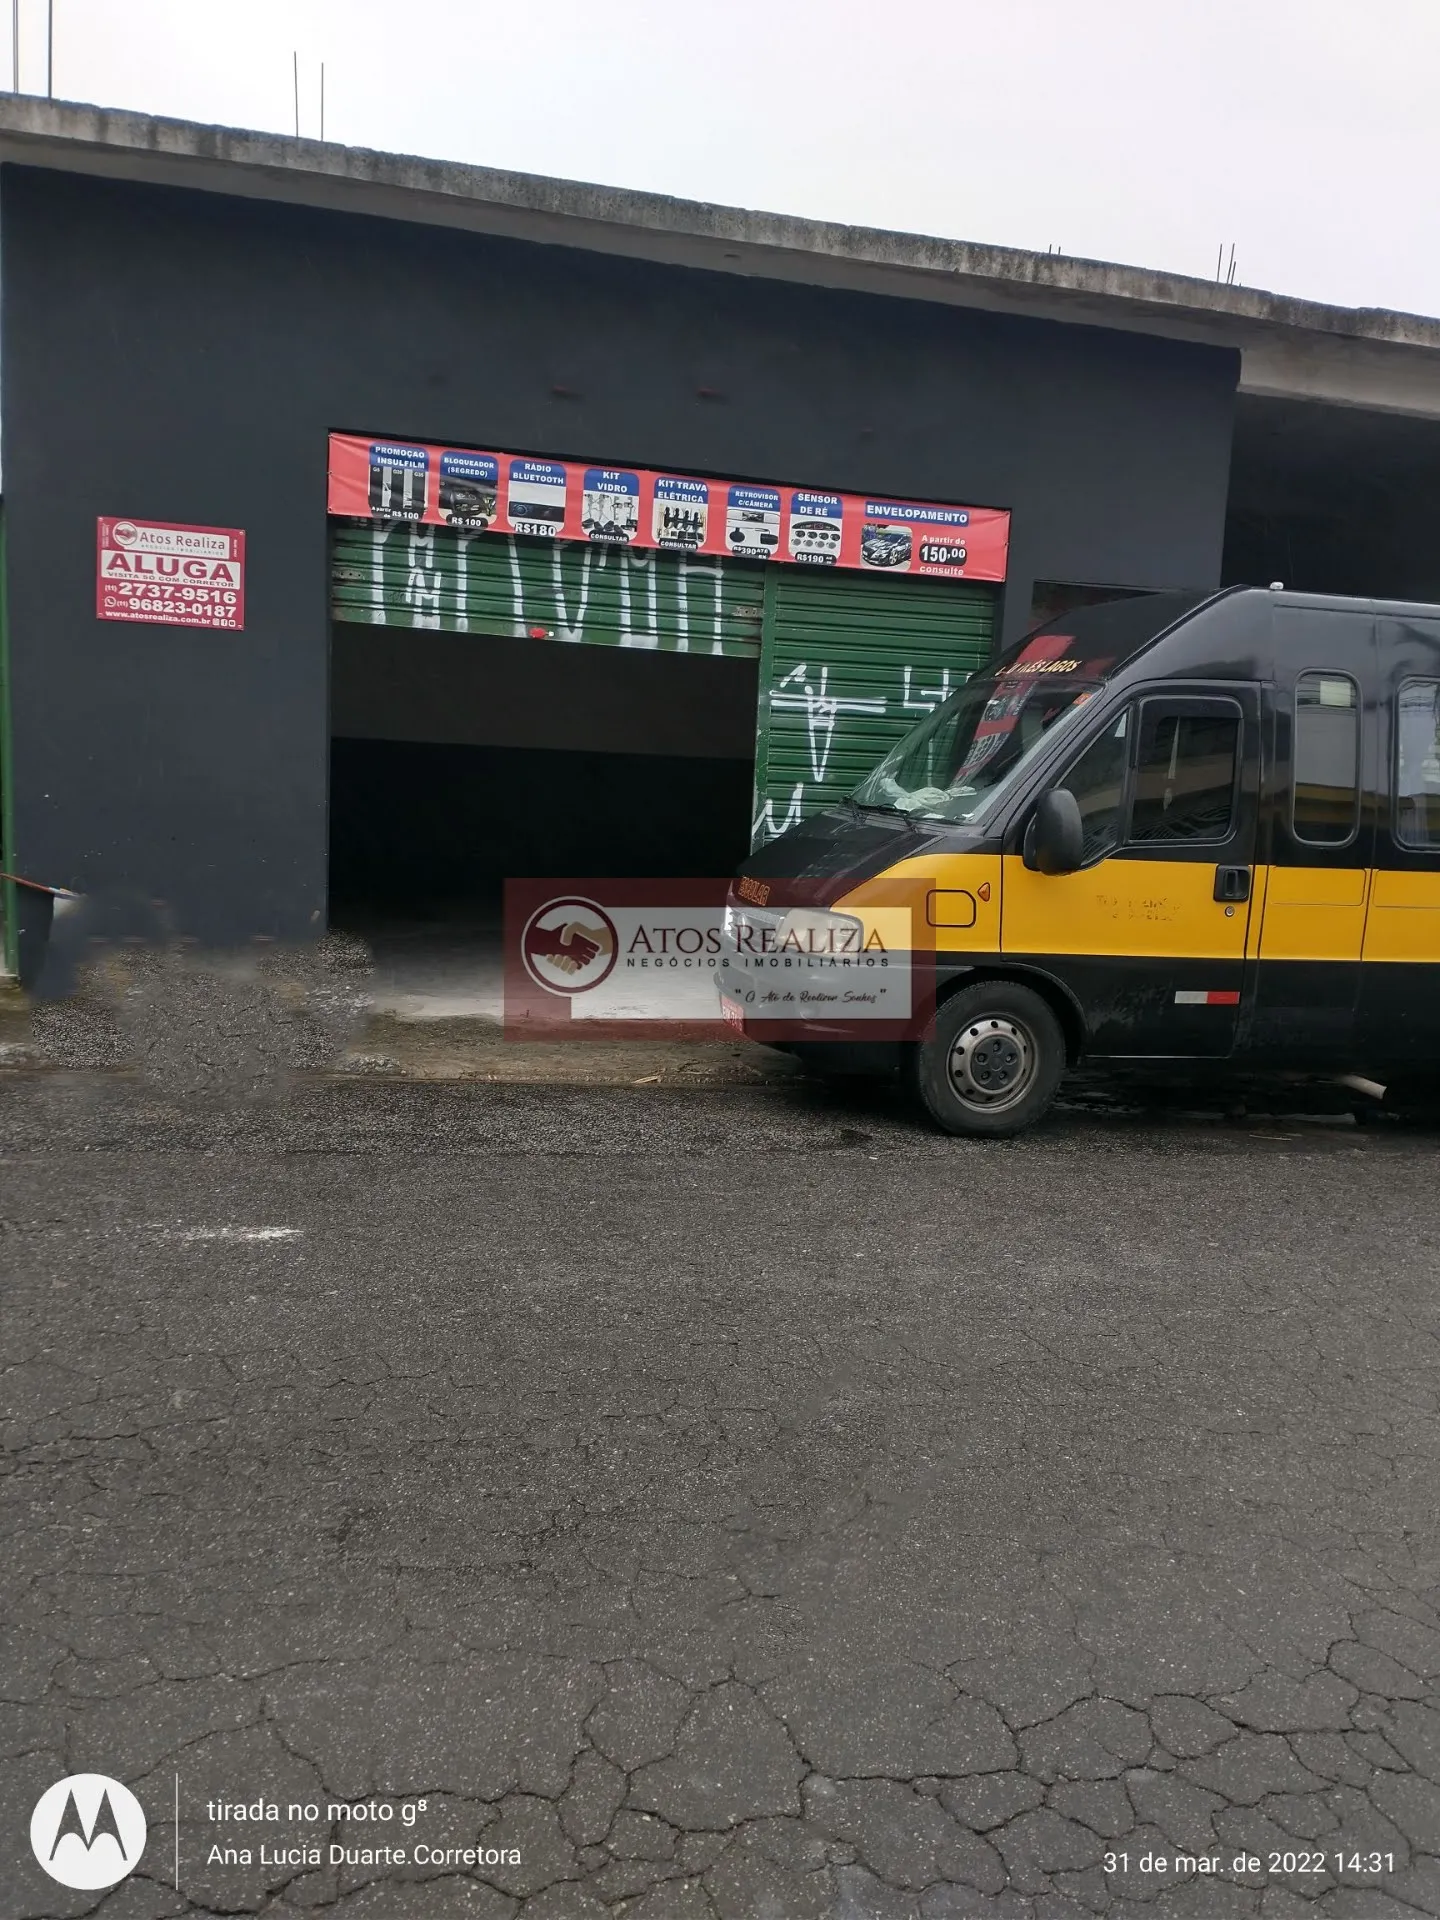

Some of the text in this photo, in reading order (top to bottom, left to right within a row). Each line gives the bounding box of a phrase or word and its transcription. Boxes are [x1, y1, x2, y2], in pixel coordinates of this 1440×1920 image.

[377, 457, 425, 469] INSULFILM
[444, 457, 495, 469] BLOQUEADOR
[524, 462, 552, 473] RÁDIO
[447, 466, 488, 478] (SEGREDO)
[602, 471, 620, 480] KIT
[512, 473, 565, 485] BLUETOOTH
[597, 482, 628, 493] VIDRO
[658, 479, 707, 492] KIT TRAVA
[657, 490, 704, 503] ELÉTRICA
[735, 490, 779, 501] RETROVISOR
[798, 493, 838, 505] SENSOR
[800, 505, 828, 516] DE RÉ
[866, 504, 968, 523] ENVELOPAMENTO
[464, 518, 482, 527] 100
[515, 522, 556, 537] R$180
[140, 531, 171, 545] Atos
[176, 535, 225, 550] Realiza
[590, 532, 628, 543] CONSULTAR
[921, 534, 966, 546] A partir de
[660, 540, 697, 550] CONSULTAR
[796, 553, 824, 564] R$190
[921, 545, 967, 563] 150,00
[106, 552, 234, 582] ALUGA
[919, 566, 965, 576] consulte
[108, 571, 140, 579] VISITA
[182, 579, 235, 588] CORRETOR
[118, 582, 237, 604] 2737-9516
[129, 597, 237, 618] 96823-0187
[105, 610, 211, 625] www.atosrealiza.com.br
